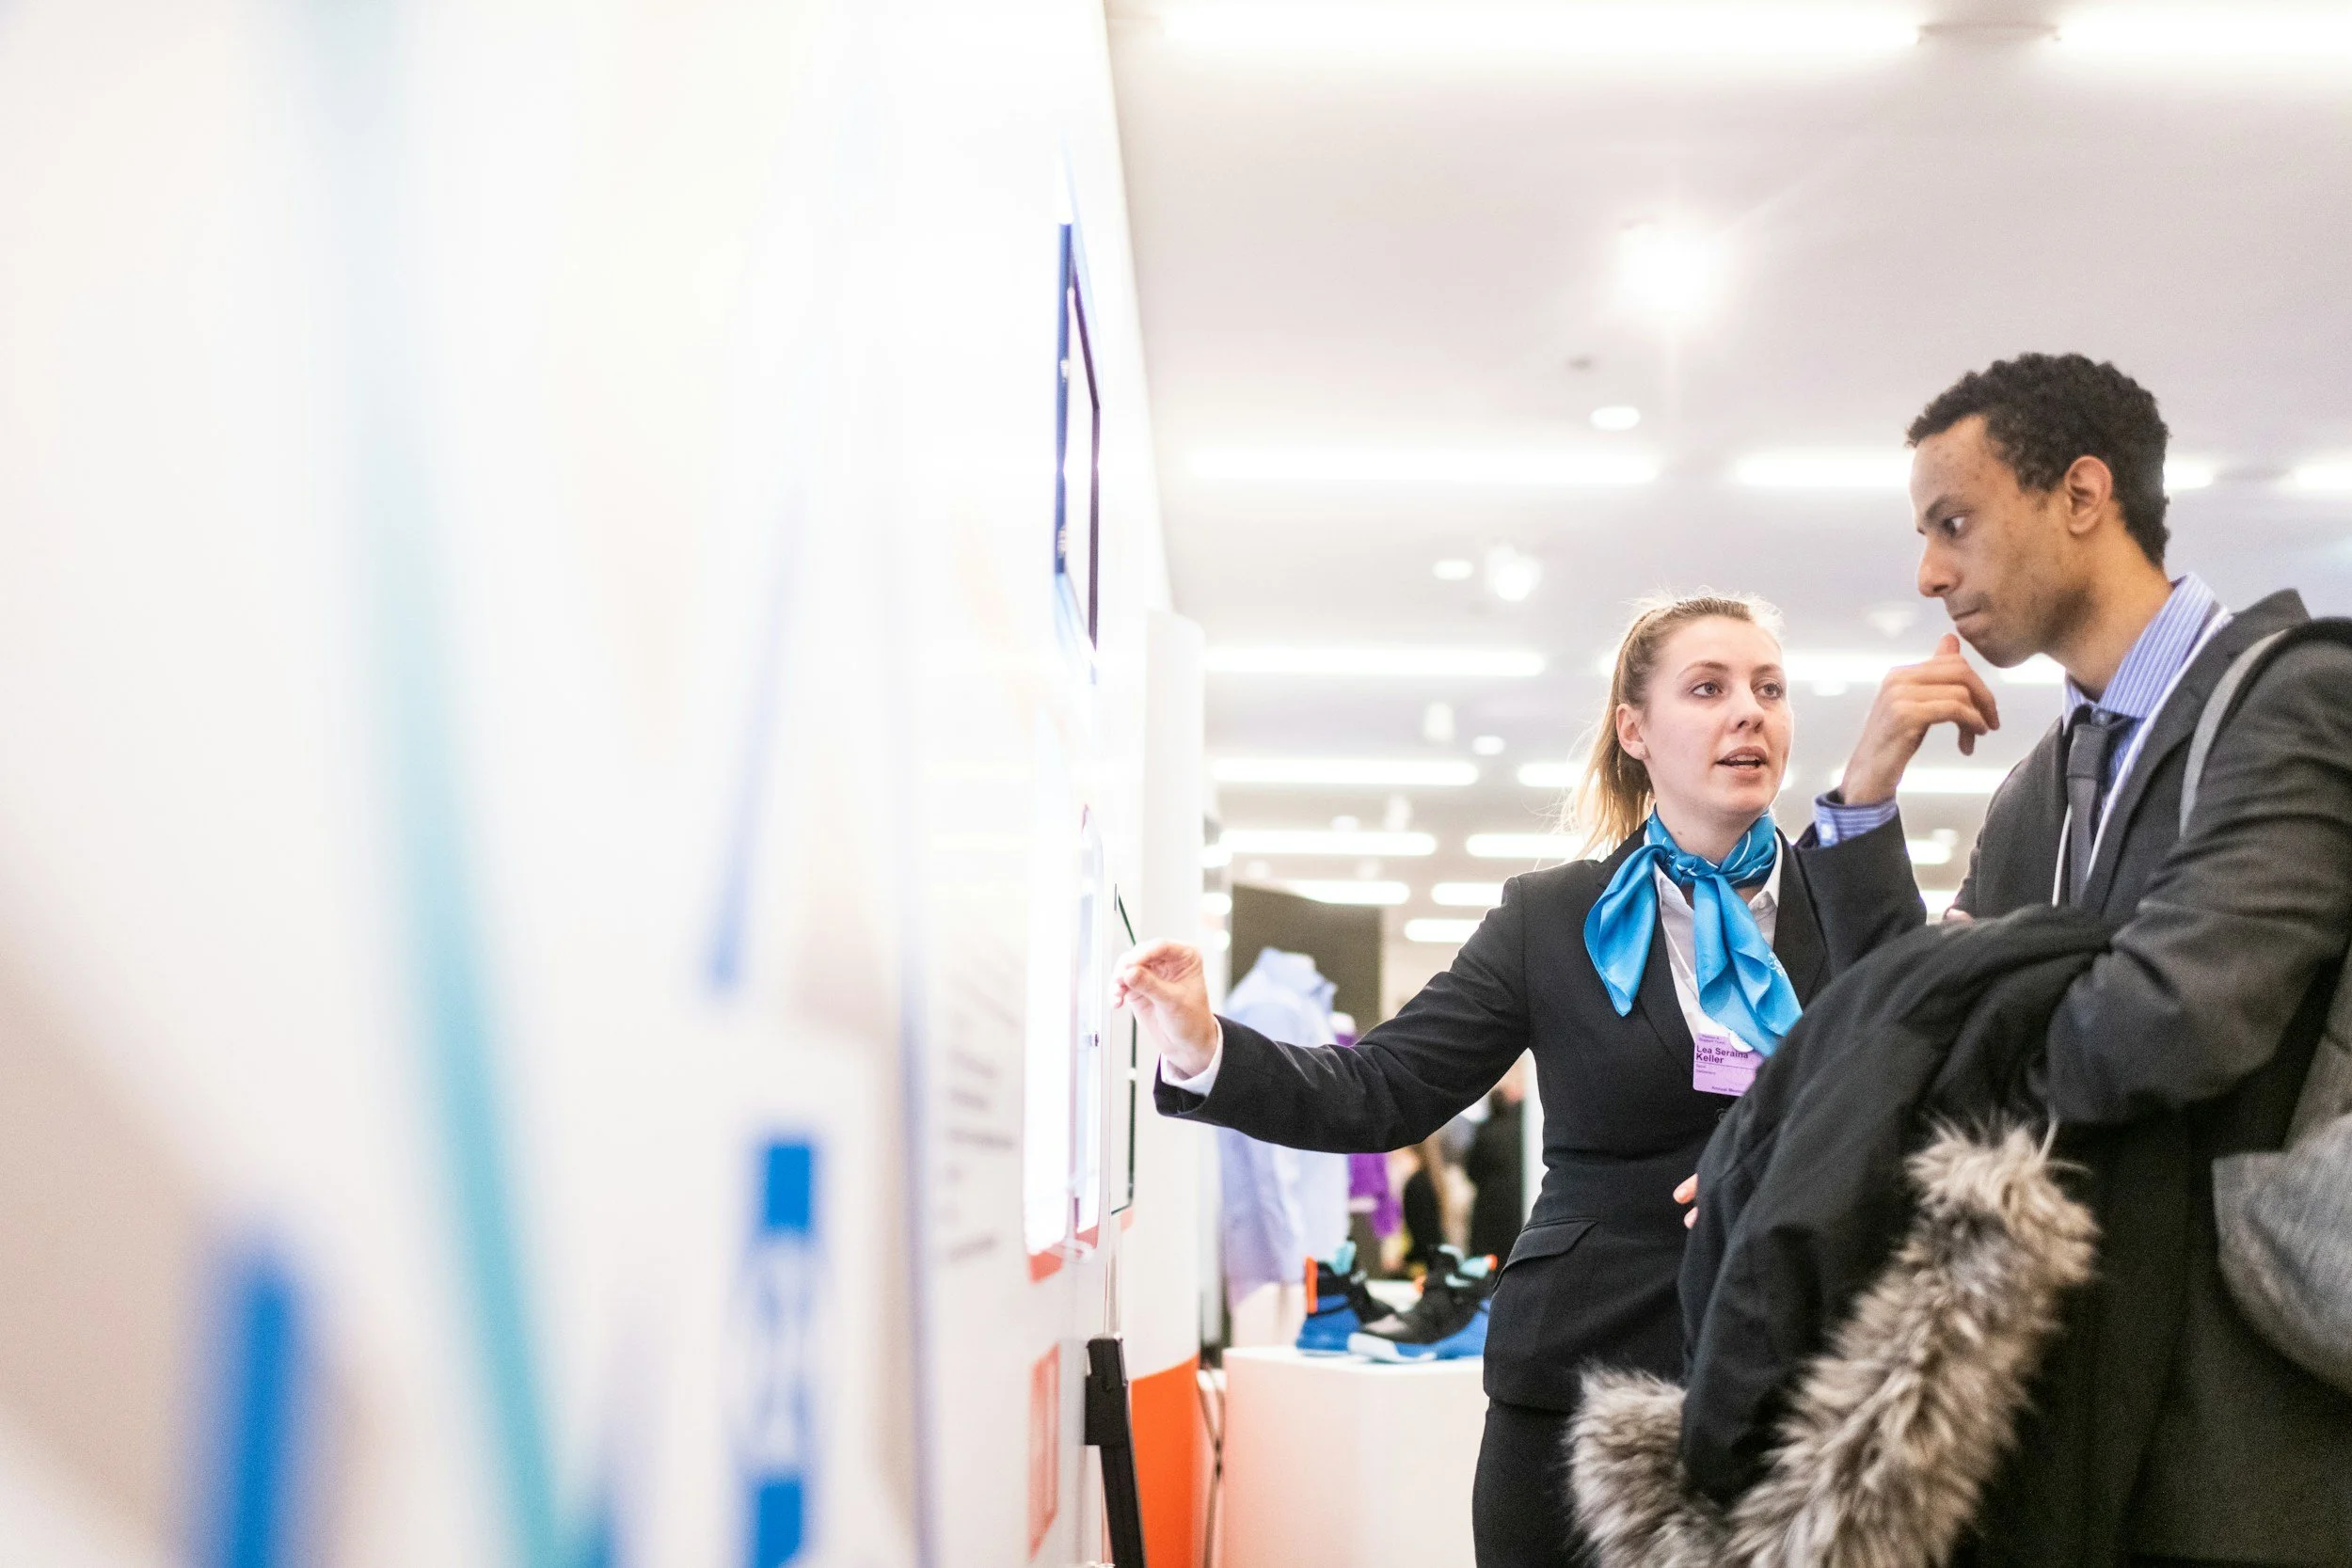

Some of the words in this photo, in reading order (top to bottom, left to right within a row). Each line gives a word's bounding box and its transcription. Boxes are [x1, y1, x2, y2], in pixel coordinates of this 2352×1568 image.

[1696, 1045, 1712, 1053] Lea
[1715, 1047, 1748, 1058] Seraina
[1696, 1053, 1724, 1063] Keller
